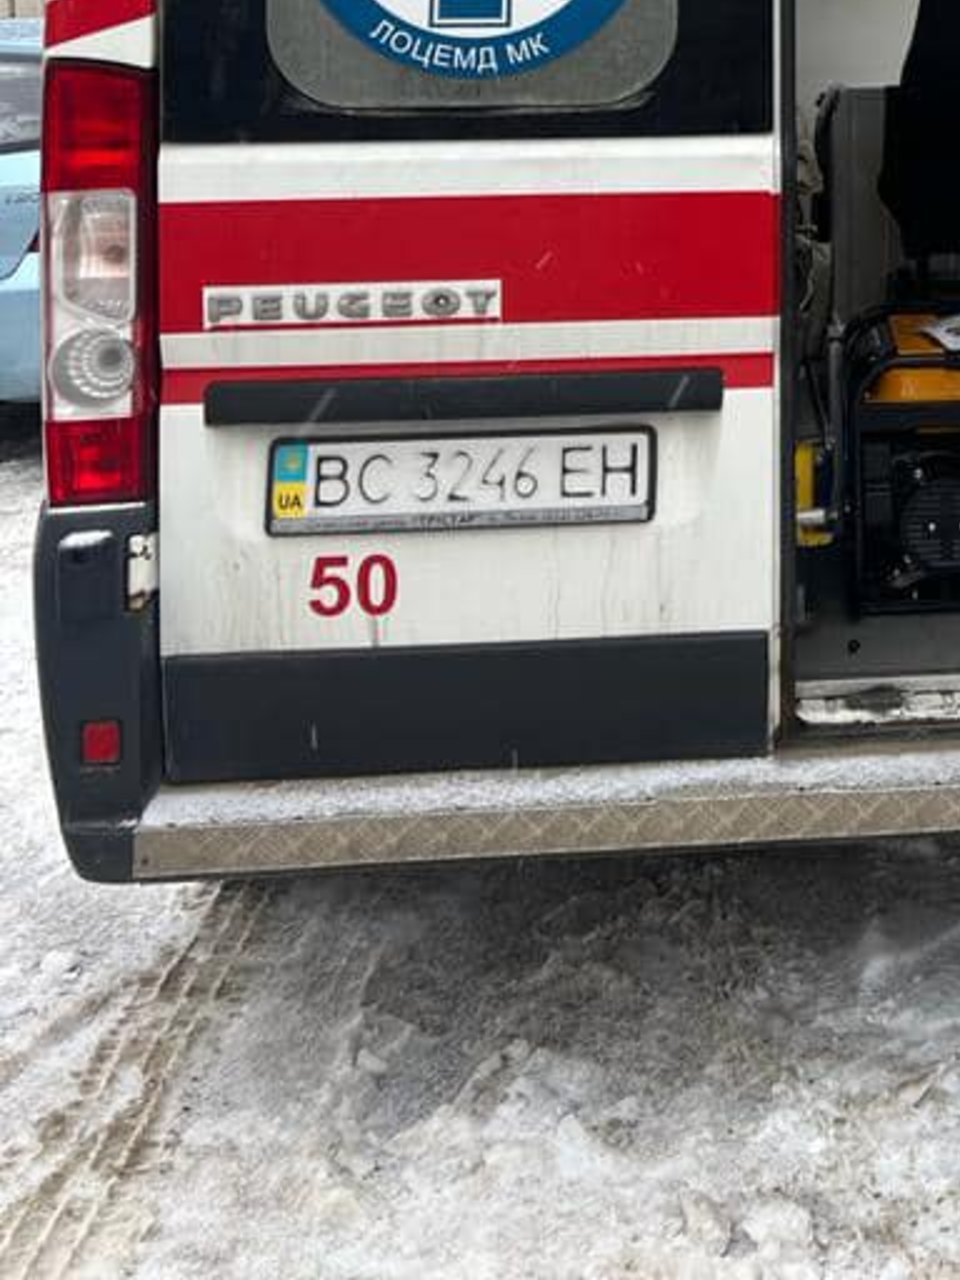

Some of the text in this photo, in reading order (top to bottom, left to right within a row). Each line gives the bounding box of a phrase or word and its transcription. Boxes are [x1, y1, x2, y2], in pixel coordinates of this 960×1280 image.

[369, 19, 549, 73] ЛОЦЕМД МК
[206, 287, 497, 323] PEUGEOT
[279, 493, 303, 510] UA
[314, 442, 637, 507] BC 3246 EH
[309, 555, 398, 616] 50
